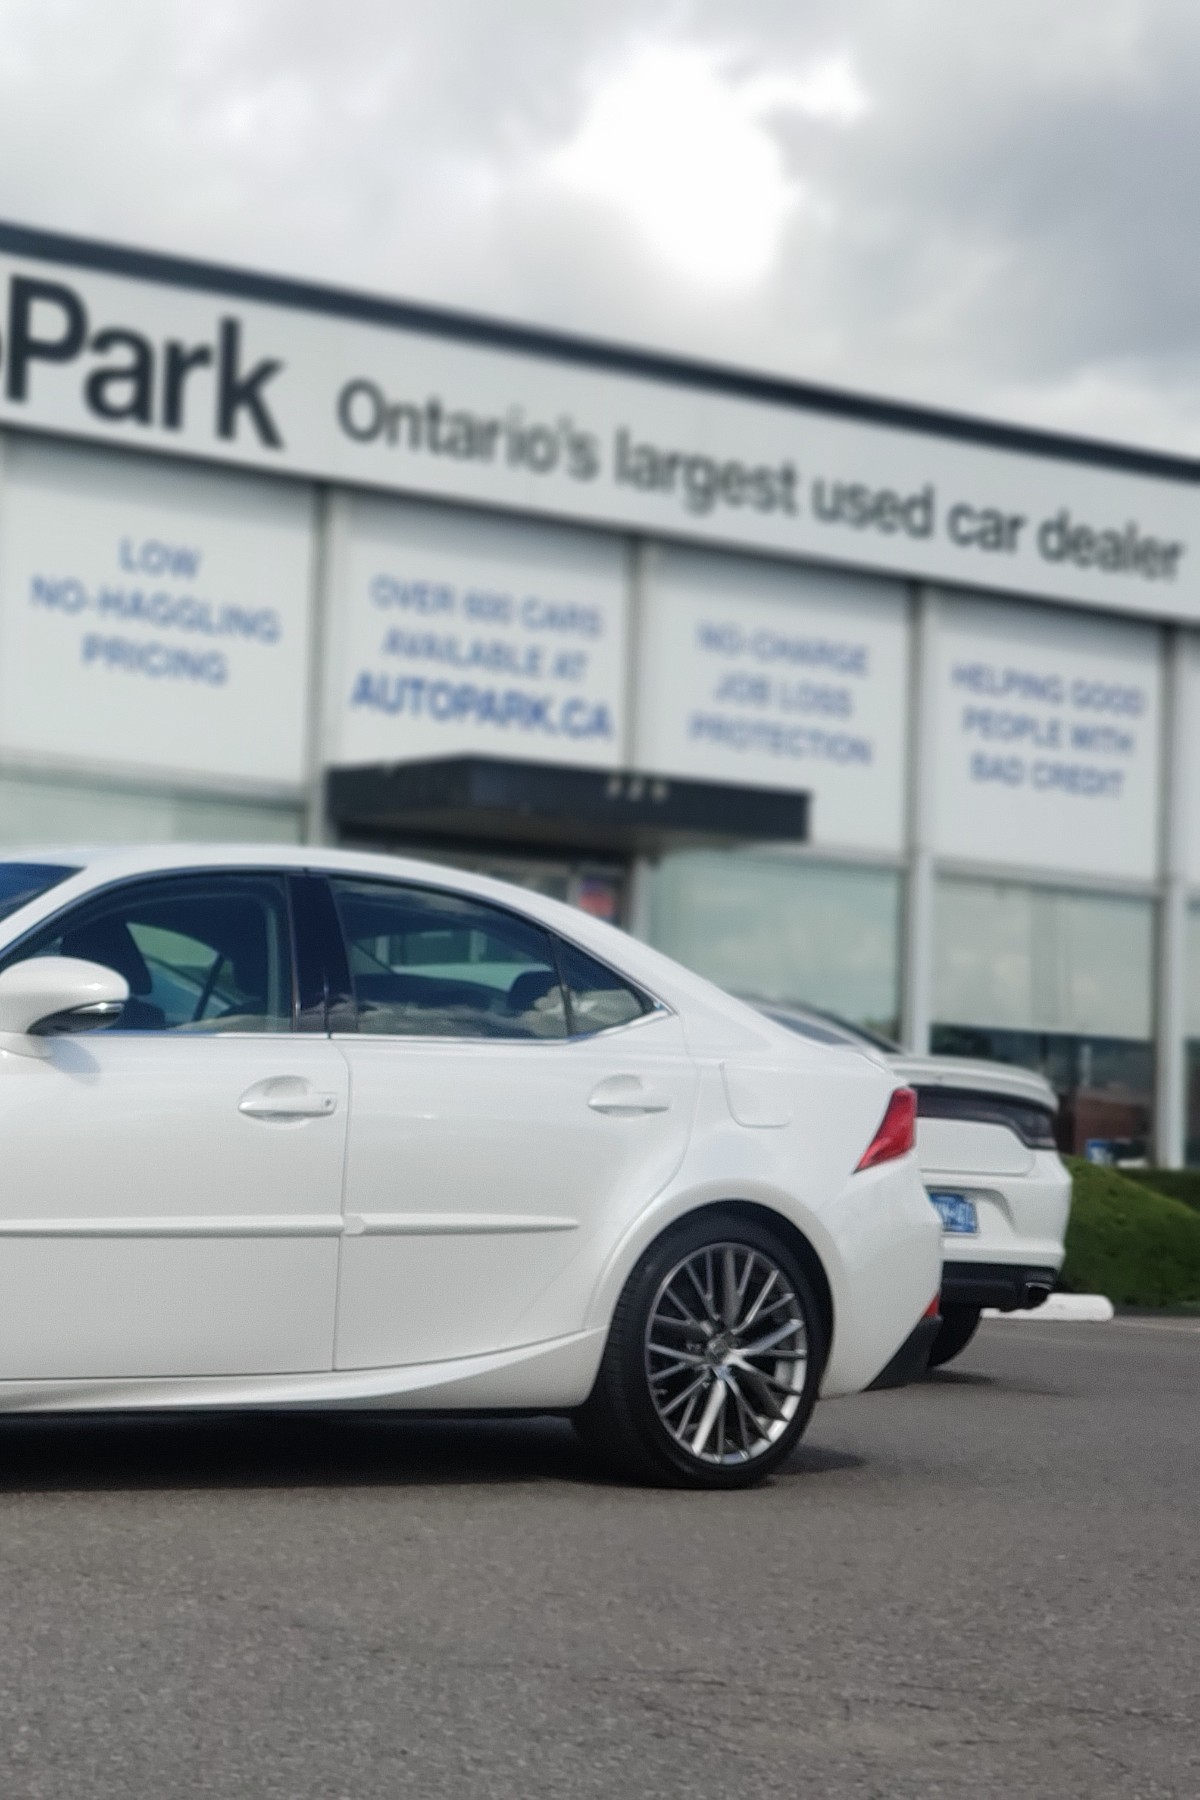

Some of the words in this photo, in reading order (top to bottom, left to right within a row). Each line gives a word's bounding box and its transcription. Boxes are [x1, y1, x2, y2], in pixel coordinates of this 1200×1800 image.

[337, 377, 600, 481] Ontario's
[615, 426, 798, 517] largest
[812, 478, 936, 541] used
[946, 501, 1028, 555] car
[1036, 507, 1186, 582] dealer
[119, 537, 201, 578] LOW
[82, 632, 228, 687] PRICING
[383, 627, 544, 679] AVAILABLE
[351, 668, 613, 742] AUTOPARK.CA
